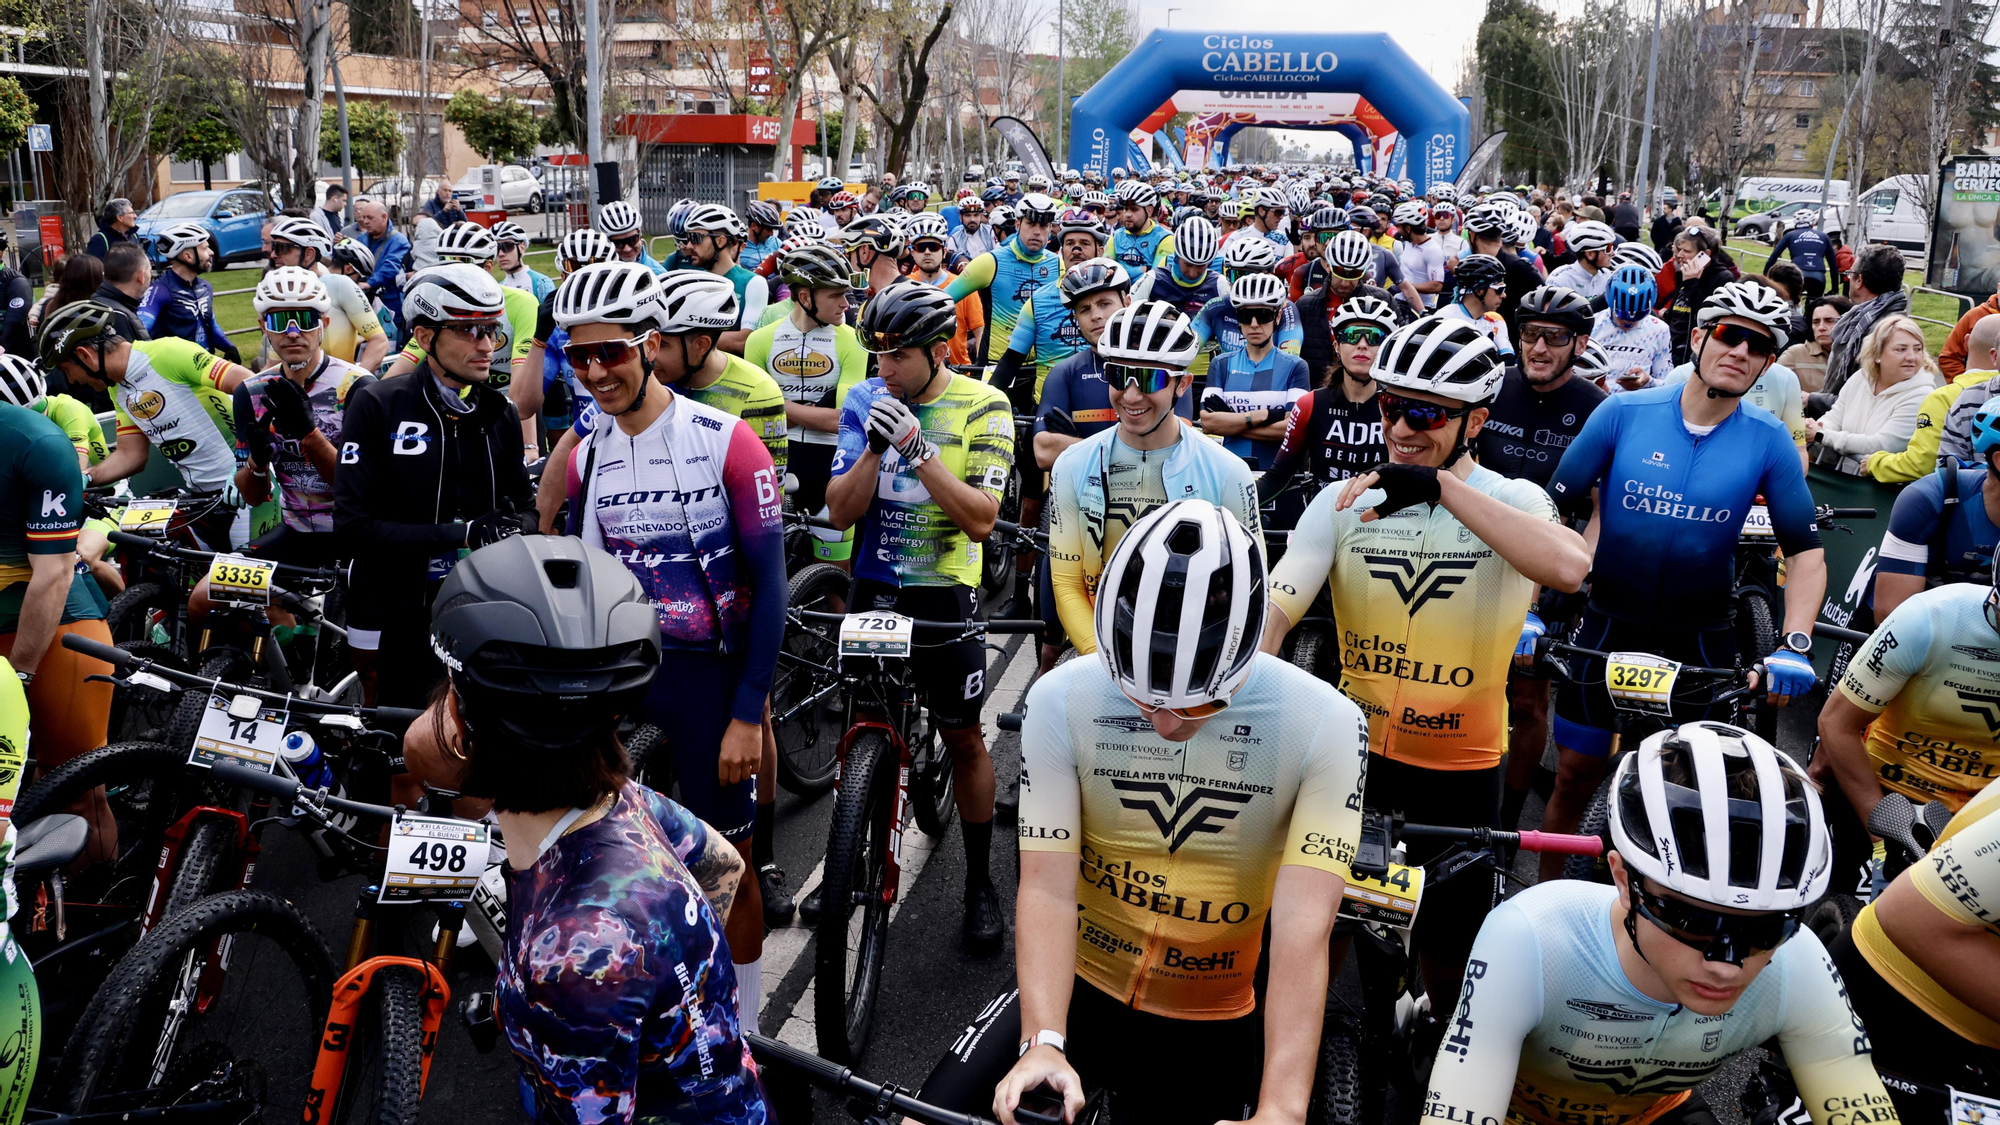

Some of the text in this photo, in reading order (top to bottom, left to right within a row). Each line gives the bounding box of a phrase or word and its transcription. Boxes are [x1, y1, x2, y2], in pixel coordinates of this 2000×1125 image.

[1203, 34, 1274, 49] Ciclos
[1202, 51, 1339, 73] CABELLO
[1445, 133, 1456, 175] Ciclos
[415, 297, 437, 317] ABUS
[636, 291, 662, 308] SCOTT
[686, 314, 736, 327] S-WORKS
[777, 358, 828, 369] Gourmet
[777, 385, 835, 393] CONWAY
[691, 414, 723, 432] 226ERS
[161, 441, 190, 457] GTO
[1503, 445, 1548, 462] ecco
[1641, 458, 1671, 470] kavant
[1624, 479, 1683, 501] Ciclos
[141, 511, 153, 522] 8
[880, 510, 930, 524] IVECO
[1622, 494, 1731, 523] CABELLO
[1381, 528, 1412, 537] EVOQUE
[1351, 546, 1388, 556] ESCUELA
[1388, 549, 1408, 557] MTB
[1442, 549, 1493, 560] FERNÁNDEZ
[215, 564, 265, 587] 3335
[858, 618, 898, 631] 720
[1226, 625, 1242, 661] PROFIT
[1345, 630, 1407, 655] Ciclos
[434, 642, 463, 672] OnlyFans
[1344, 649, 1475, 688] CABELLO
[1613, 666, 1668, 688] 3297
[1208, 667, 1231, 699] Spiuk
[1943, 680, 1983, 693] ESCUELA
[1402, 707, 1465, 730] BeeHi
[228, 718, 259, 744] 14
[1219, 734, 1263, 746] kavant
[1095, 742, 1170, 756] STUDIO EVOQUE
[1904, 731, 1983, 760] Ciclos
[1093, 768, 1140, 780] ESCUELA
[1142, 772, 1166, 781] MTB
[1208, 778, 1274, 796] FERNÁNDEZ
[1305, 832, 1356, 854] Ciclos
[409, 841, 467, 873] 498
[1080, 844, 1167, 888] Ciclos
[1658, 836, 1675, 877] Spiuk
[1080, 860, 1250, 925] CABELLO
[1799, 867, 1818, 901] Spiuk
[1378, 909, 1409, 922] Smilke
[1082, 932, 1117, 955] casa
[1086, 926, 1144, 956] ocasión
[1163, 946, 1240, 972] BeeHi
[1203, 971, 1242, 981] nutrition
[1444, 958, 1489, 1063] BeeHi
[1559, 1023, 1641, 1045] STUDIO EVOQUE
[1549, 1046, 1602, 1066] ESCUELA
[1605, 1058, 1632, 1066] MTB
[1823, 1092, 1889, 1112] Ciclos
